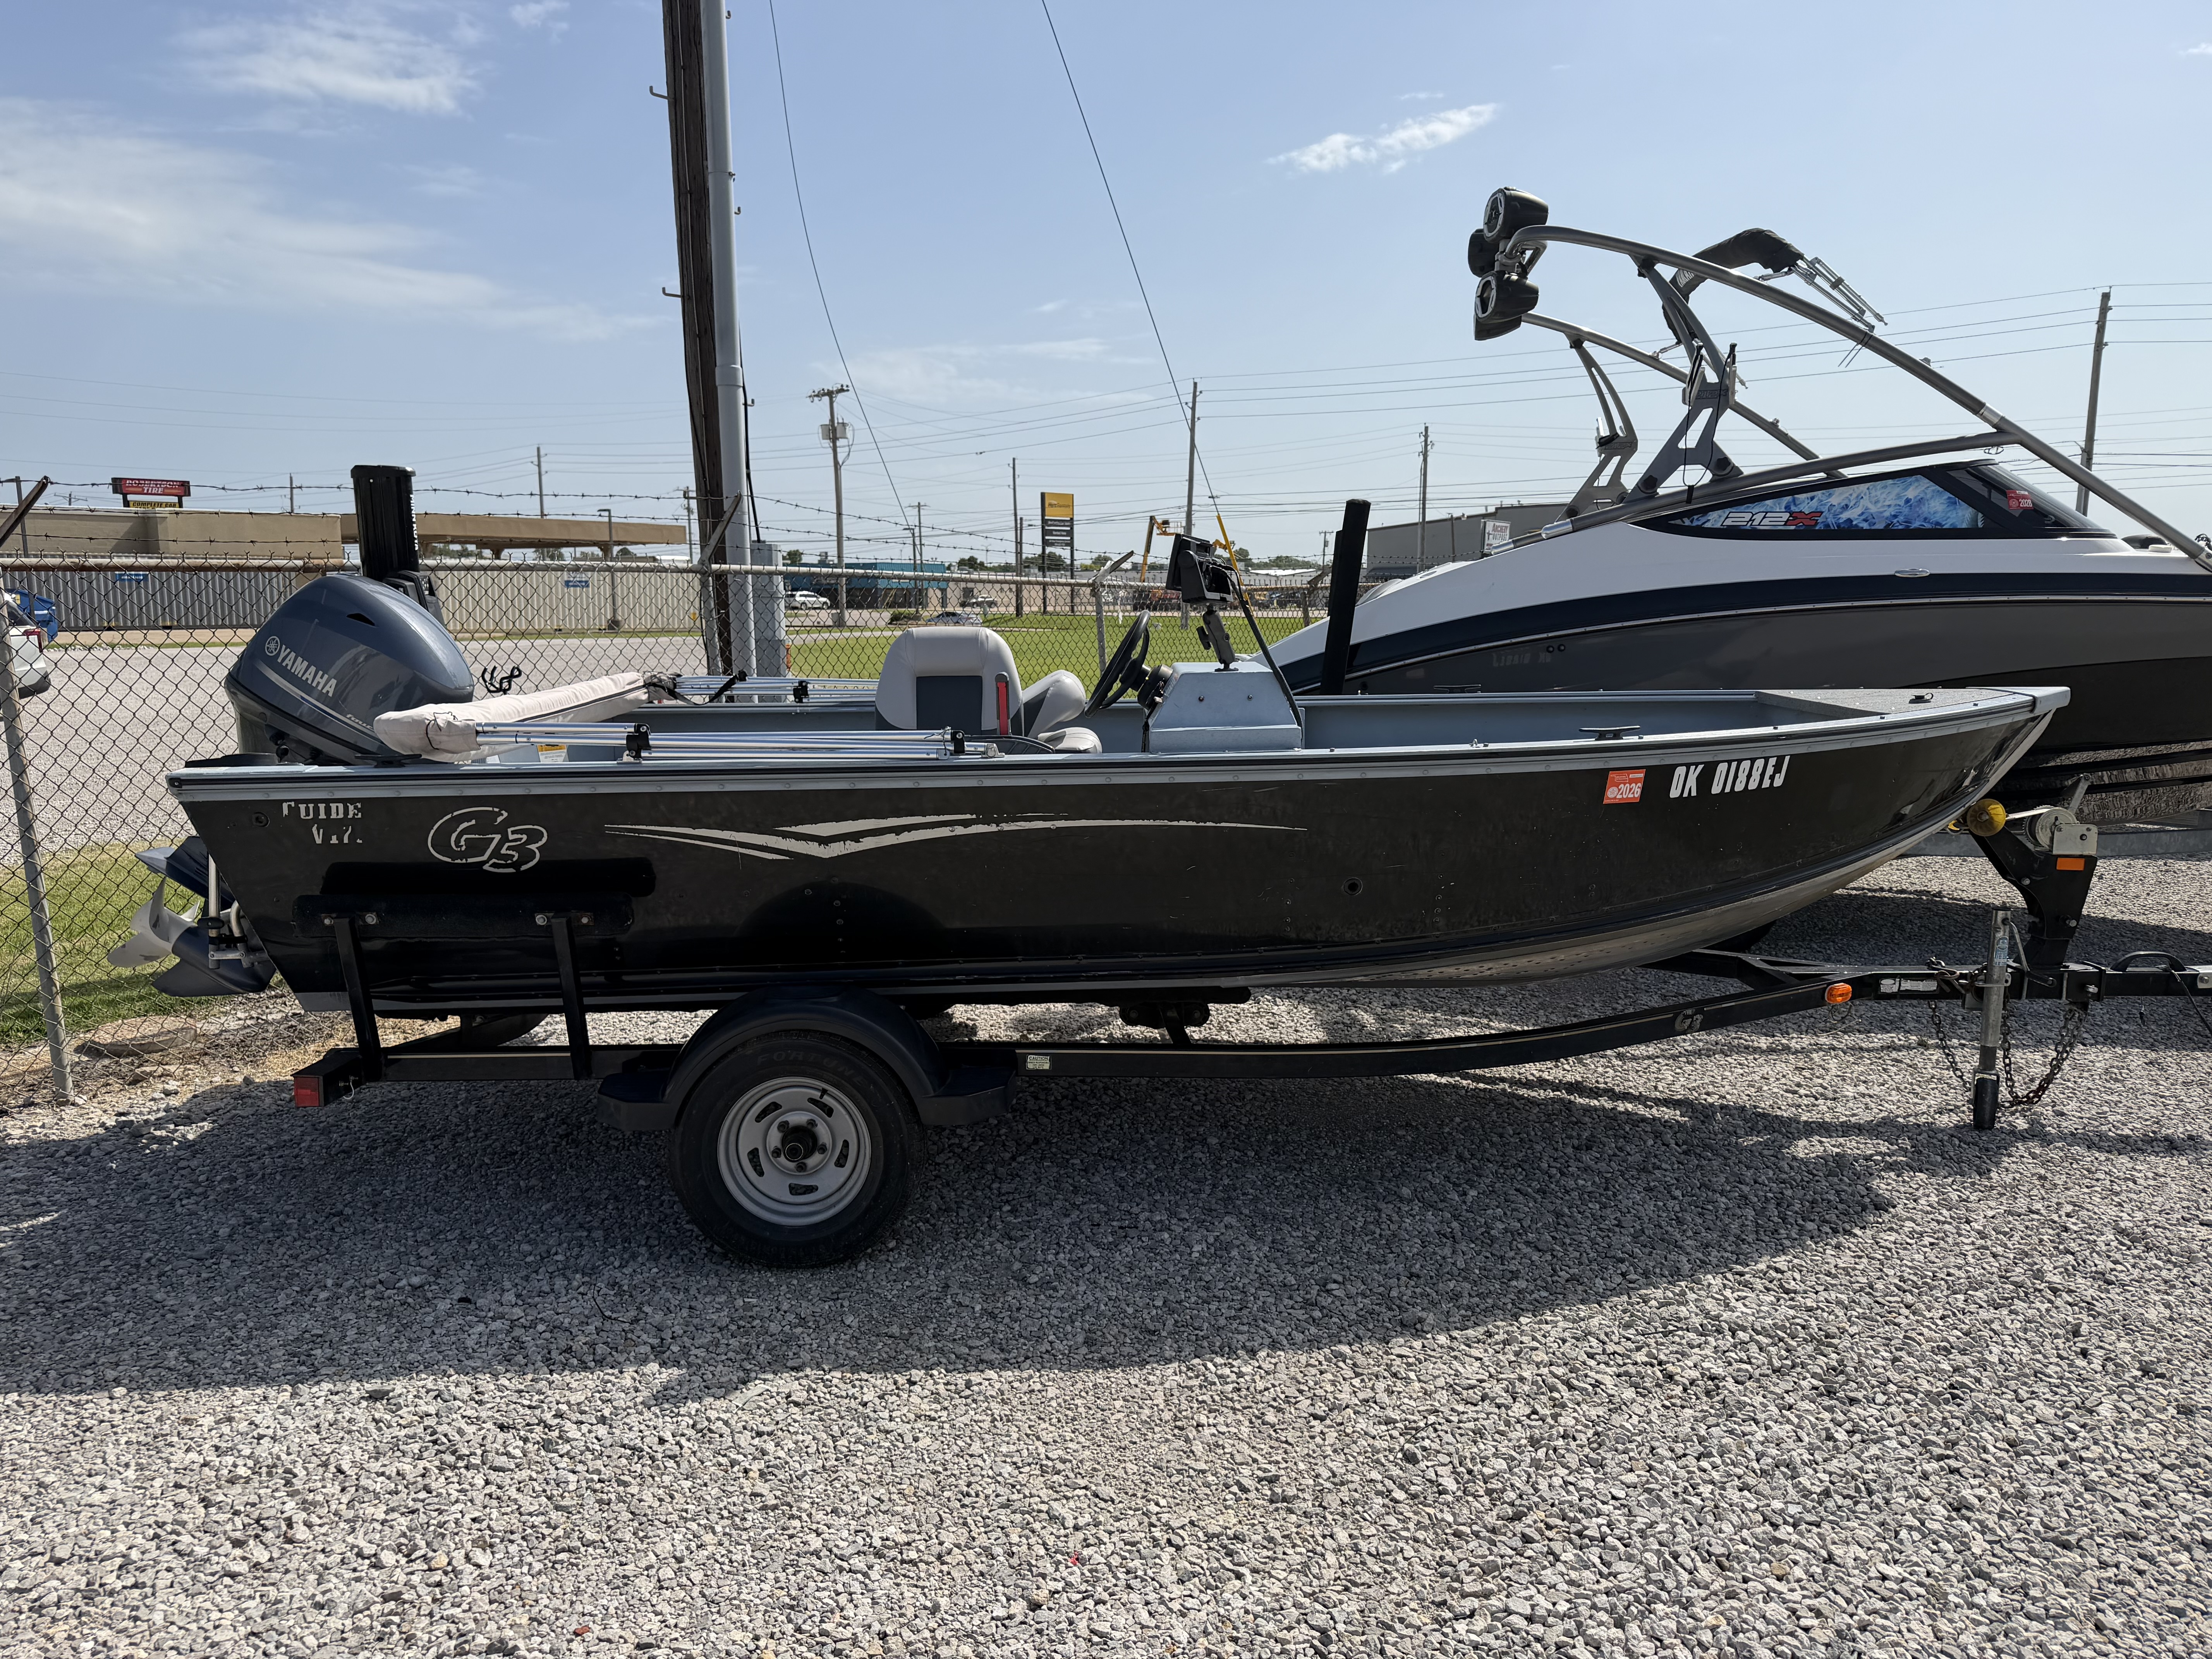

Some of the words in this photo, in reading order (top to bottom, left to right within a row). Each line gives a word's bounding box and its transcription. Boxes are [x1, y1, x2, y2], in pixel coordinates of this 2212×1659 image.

[126, 480, 179, 488] ROBERTSON
[1722, 512, 1822, 526] 212X
[277, 644, 337, 697] YAMAHA
[1616, 783, 1642, 799] 2026
[1669, 764, 1705, 798] OK
[1711, 755, 1790, 794] 0188EJ
[427, 806, 548, 873] G3
[757, 1051, 867, 1087] FORTUNE
